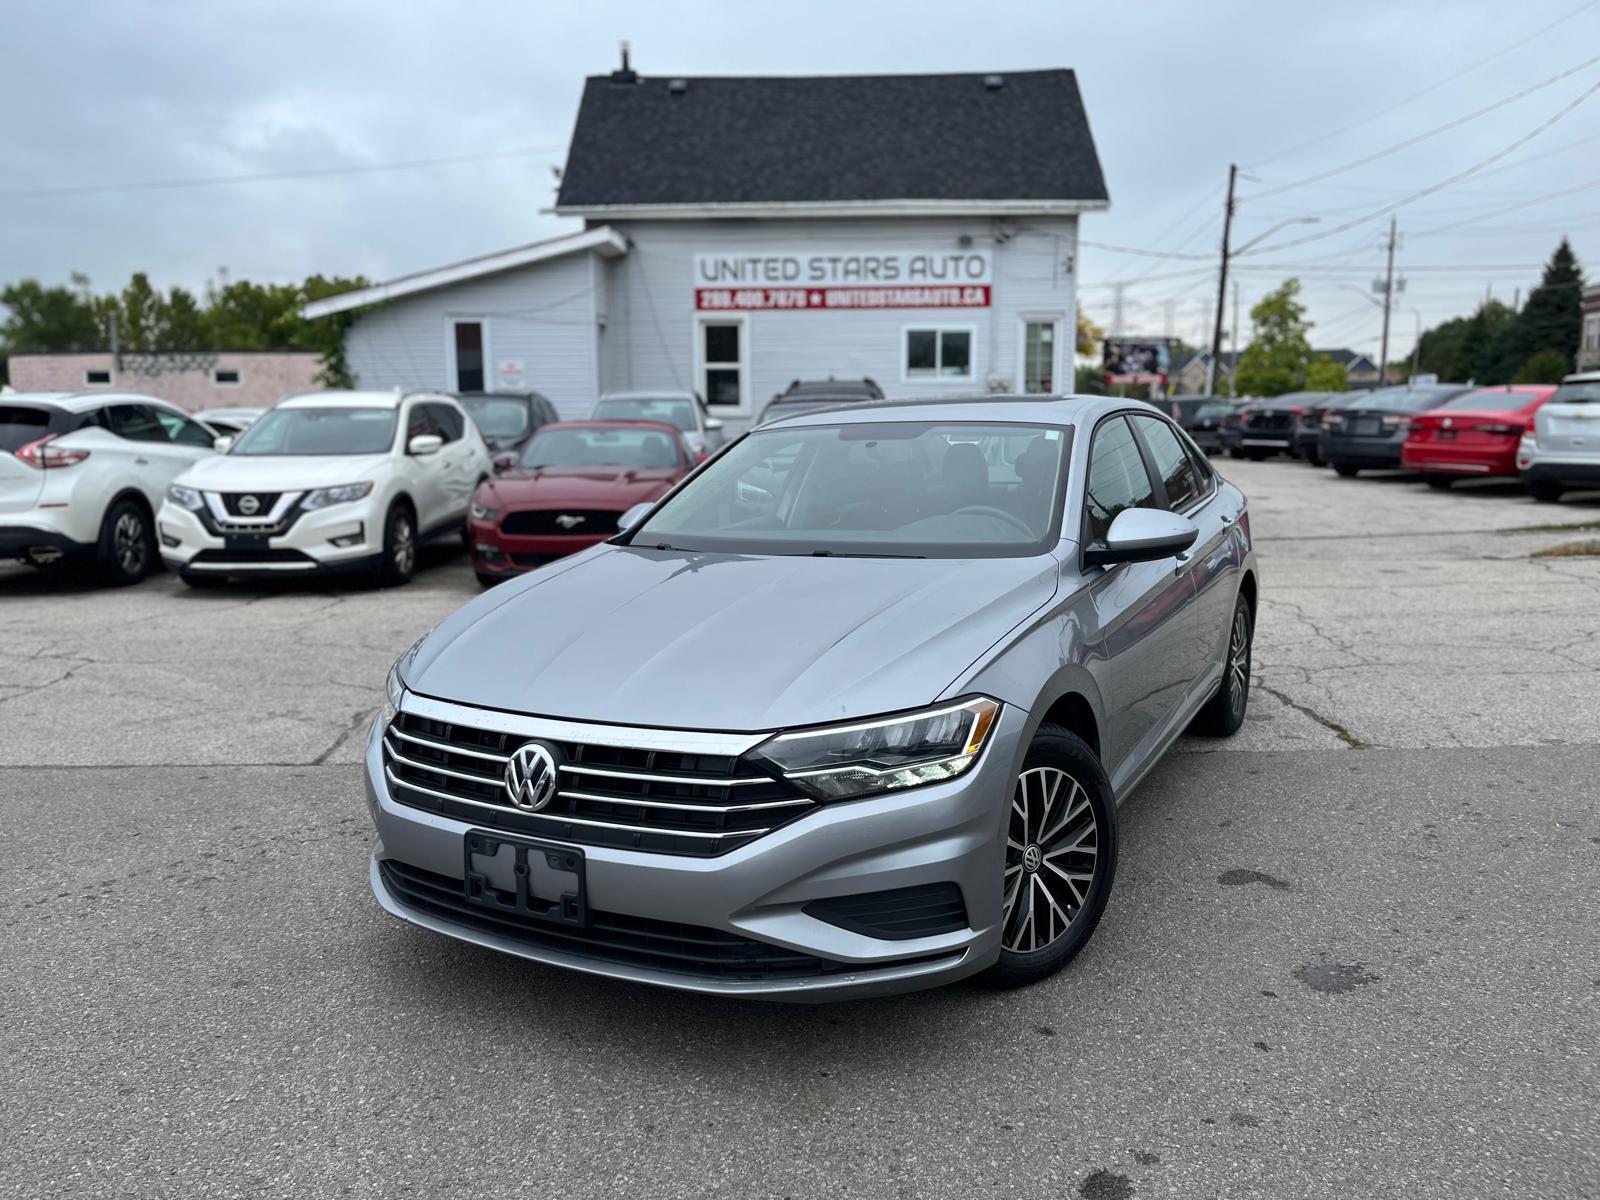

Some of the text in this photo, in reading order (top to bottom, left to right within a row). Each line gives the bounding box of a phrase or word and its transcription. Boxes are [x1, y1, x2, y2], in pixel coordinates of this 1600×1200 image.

[700, 255, 986, 281] UNITED STARS AUTO
